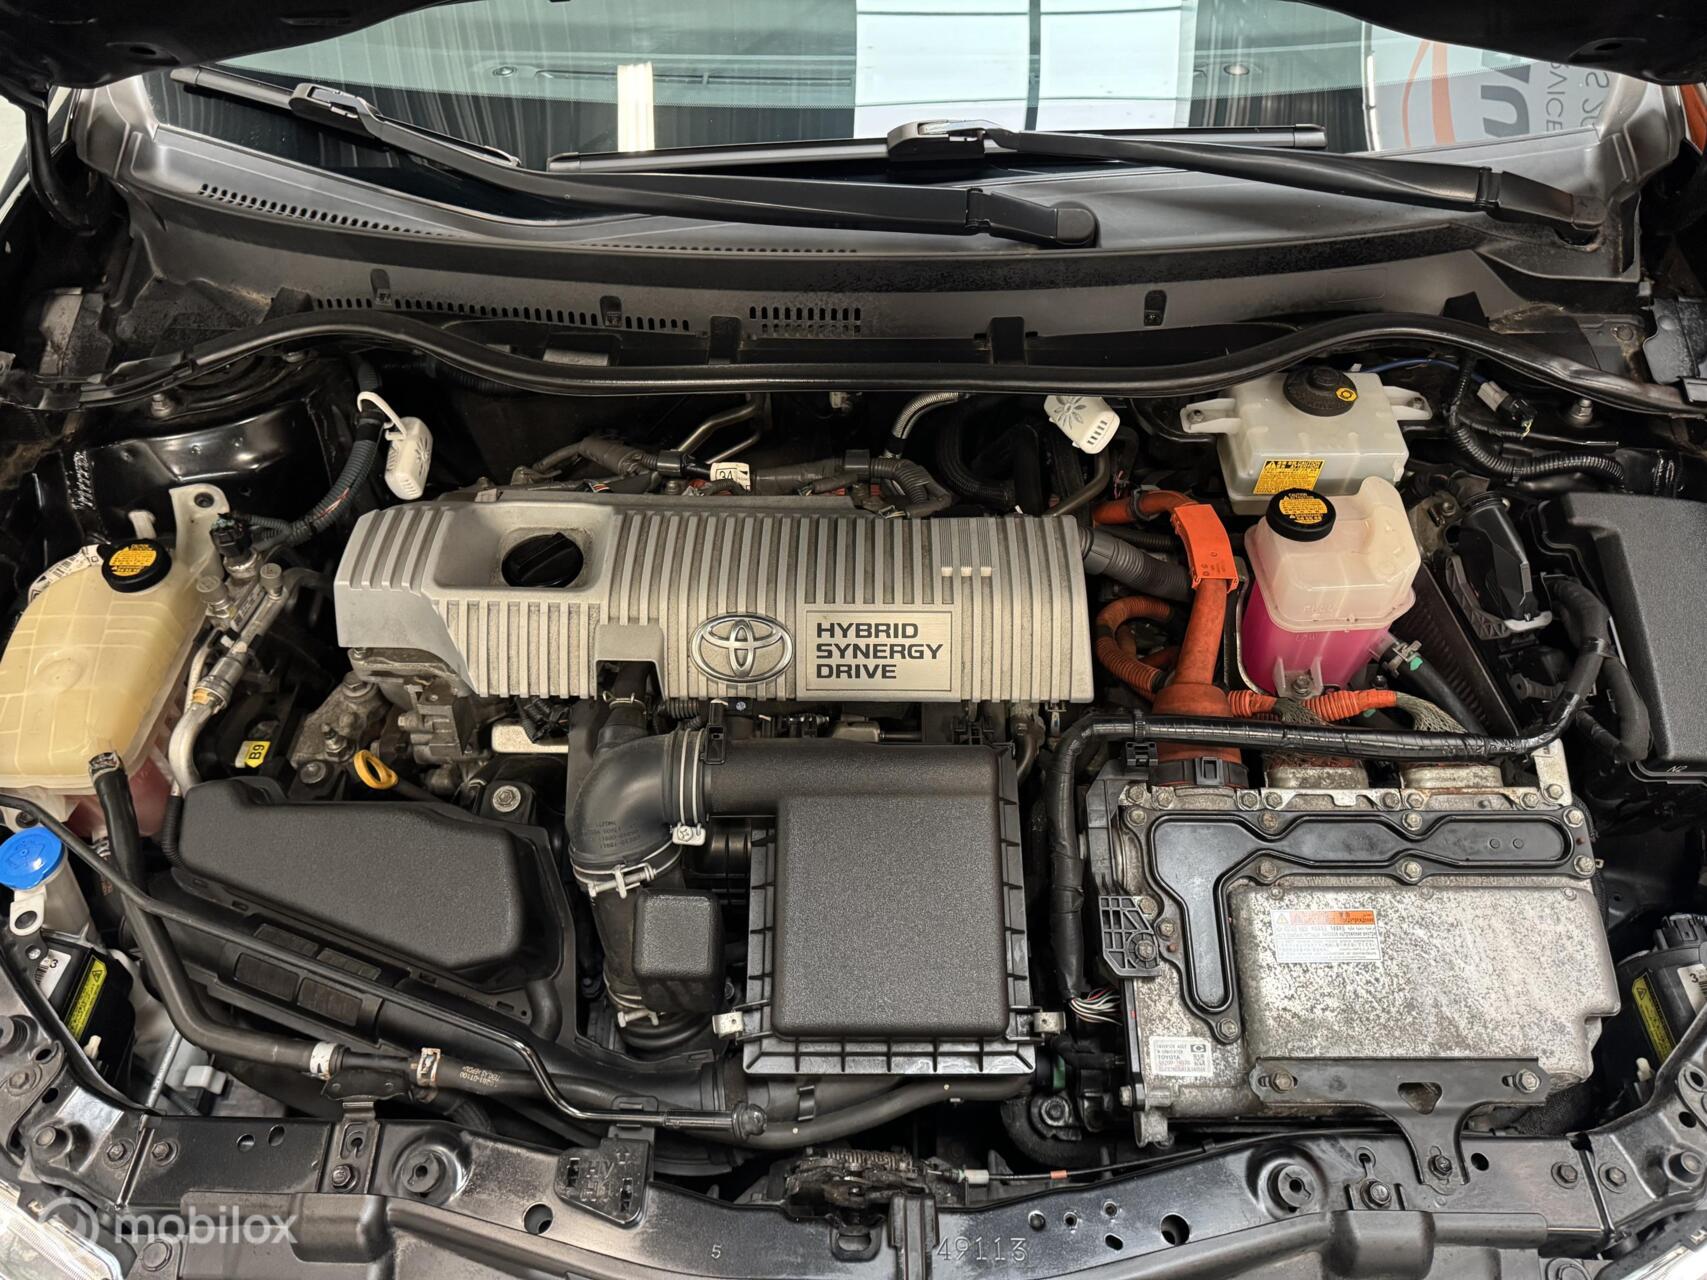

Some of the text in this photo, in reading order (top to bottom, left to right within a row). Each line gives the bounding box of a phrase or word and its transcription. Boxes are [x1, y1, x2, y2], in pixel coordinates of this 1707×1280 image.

[816, 622, 919, 639] HYBRID
[816, 643, 944, 660] SYNERGY
[816, 664, 897, 679] DRIVE
[248, 744, 265, 760] B9
[710, 1244, 722, 1260] 5
[935, 1236, 1028, 1262] 49113
